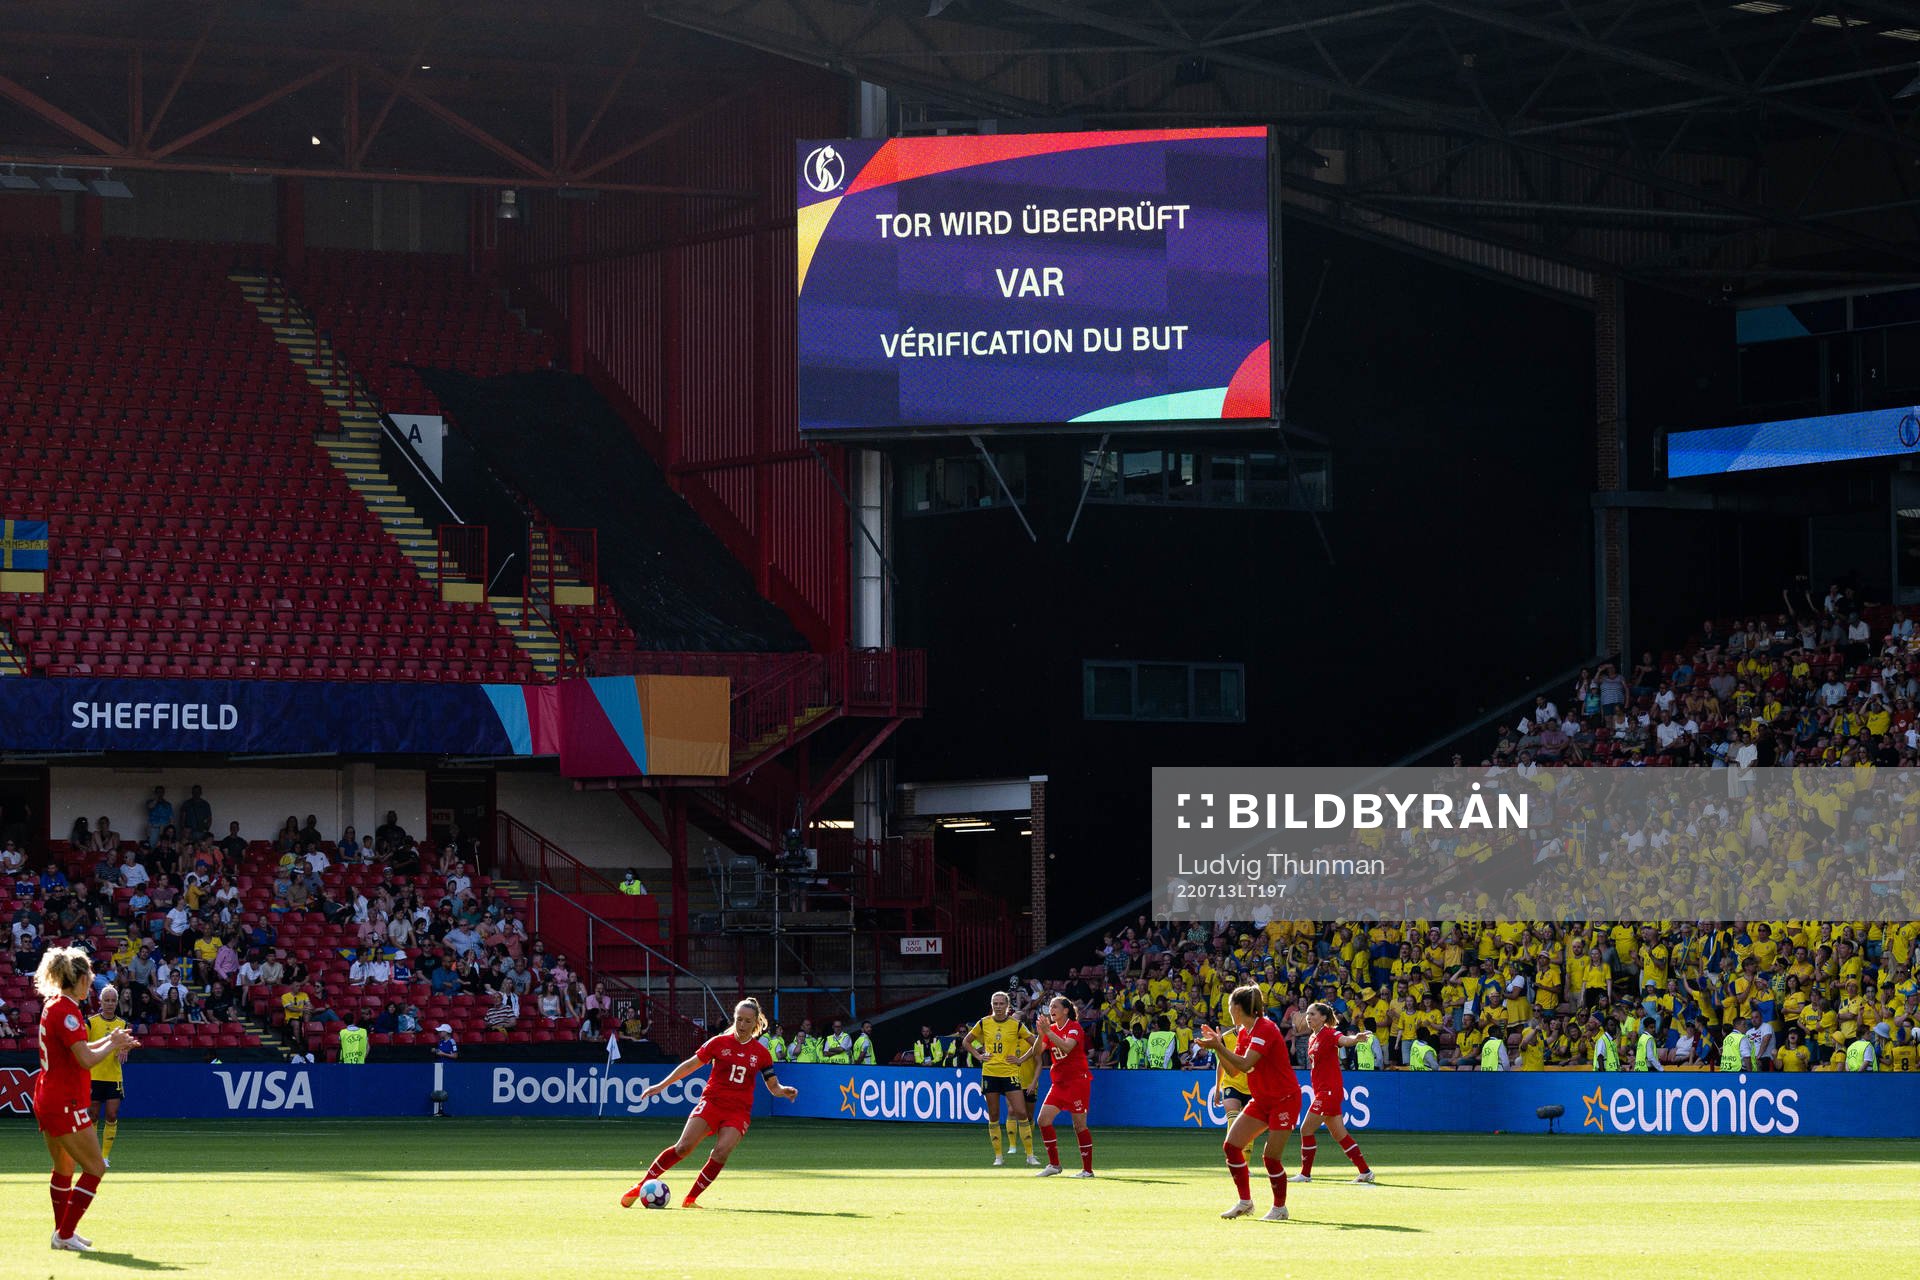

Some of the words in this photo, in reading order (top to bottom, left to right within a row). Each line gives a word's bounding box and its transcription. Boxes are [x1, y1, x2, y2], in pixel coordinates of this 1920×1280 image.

[876, 213, 932, 239] TOR
[939, 210, 1013, 236] WIRD
[1022, 200, 1190, 234] ÜBERPRÜFT
[995, 267, 1065, 298] VAR
[880, 326, 1073, 358] VÉRIFICATION
[1083, 327, 1122, 353] DU
[1132, 325, 1189, 351] BUT
[408, 424, 423, 443] A
[71, 701, 238, 730] SHEFFIELD
[926, 939, 937, 952] M
[992, 1042, 1003, 1054] 18
[729, 1064, 747, 1084] 13
[212, 1071, 314, 1110] VISA
[493, 1067, 708, 1113] Booking.co
[1610, 1073, 1799, 1134] euronics
